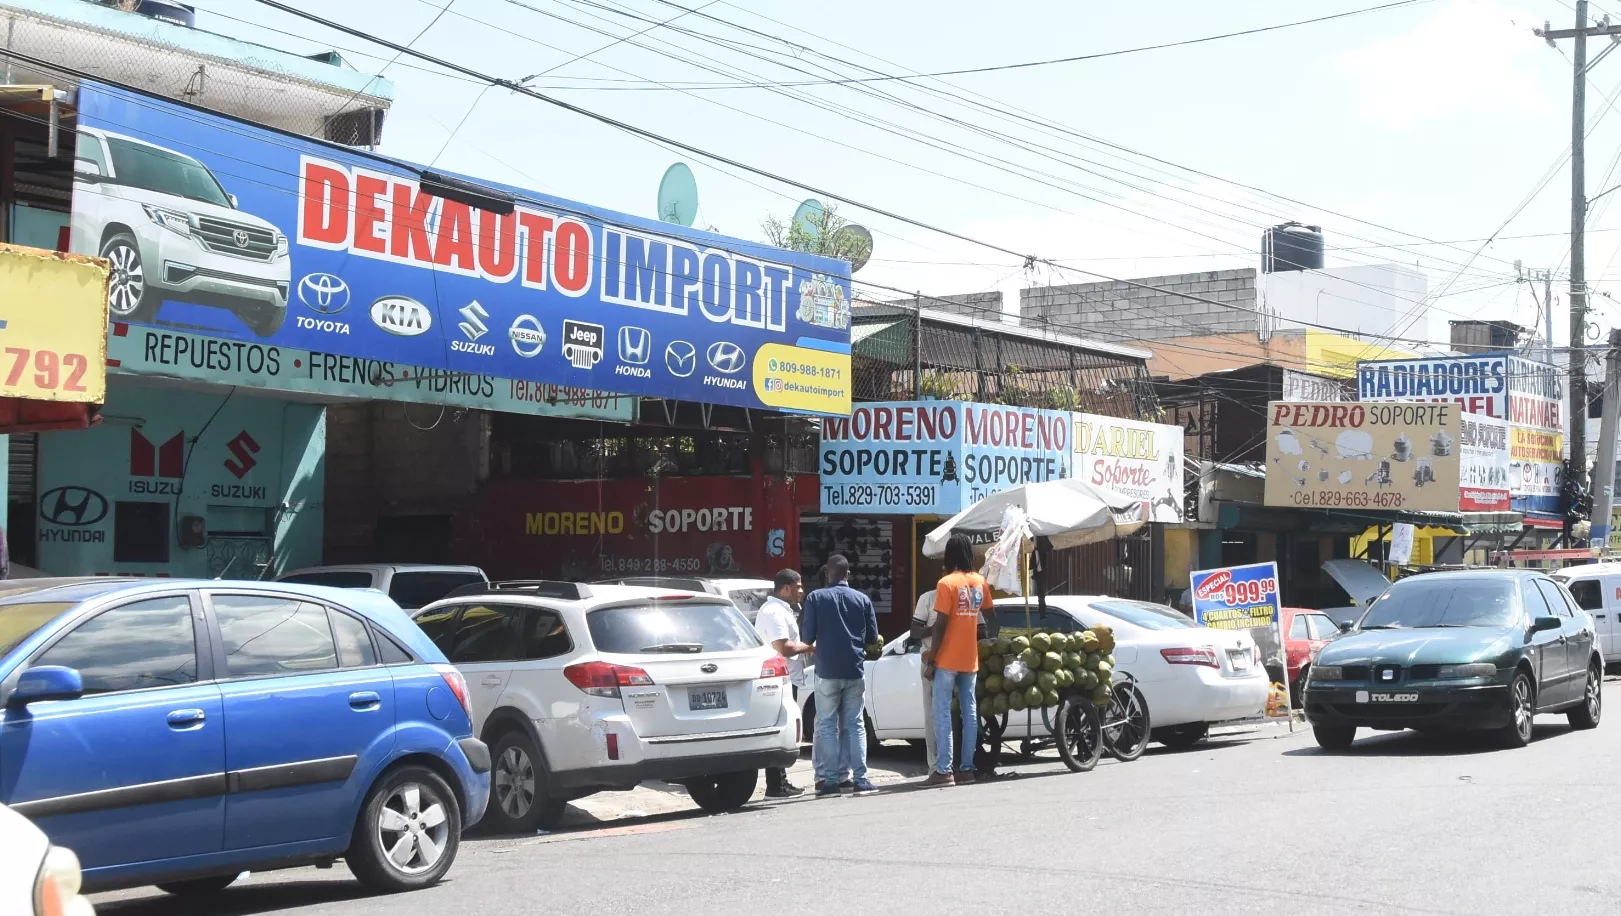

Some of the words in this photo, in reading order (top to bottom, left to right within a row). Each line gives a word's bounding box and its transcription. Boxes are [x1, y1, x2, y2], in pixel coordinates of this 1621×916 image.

[297, 154, 594, 298] DEKAUTO
[600, 224, 793, 332] IMPORT
[296, 316, 351, 335] TOYOTA
[380, 302, 424, 330] KIA
[512, 330, 543, 342] NISSAN
[569, 325, 598, 345] Jeep
[450, 340, 495, 356] SUZUKI
[145, 332, 281, 376] REPUESTOS
[309, 351, 395, 387] FRENOS
[413, 364, 494, 398] VIDRIOS
[615, 365, 651, 379] HONDA
[779, 361, 841, 380] 809-988-1871
[703, 375, 747, 390] HYUNDAI
[784, 381, 845, 398] dekautoimport
[1361, 361, 1505, 399] RADIADORES
[1271, 403, 1366, 429] PEDRO
[1369, 405, 1449, 426] SOPORTE
[1509, 394, 1562, 430] NATANAEL
[822, 405, 957, 441] MORENO
[964, 407, 1067, 451] MORENO
[822, 449, 942, 476] SOPORTE
[964, 453, 1056, 484] SOPORTE
[1091, 456, 1157, 490] Soporte
[128, 481, 184, 495] ISUZU
[211, 484, 267, 499] SUZUKI
[823, 485, 936, 506] Tel.829-703-5391
[525, 511, 624, 535] MORENO
[648, 506, 753, 533] SOPORTE
[39, 528, 105, 543] HYUNDAI
[968, 529, 1001, 545] VALE
[1197, 572, 1230, 598] ESPECIAL
[1202, 611, 1209, 623] 4
[1208, 608, 1243, 621] CUARTOS
[1249, 605, 1275, 617] FILTRO
[1207, 619, 1236, 631] CAMBIO
[1237, 616, 1272, 630] INCLUIDO
[1371, 693, 1419, 702] TOLEDO
